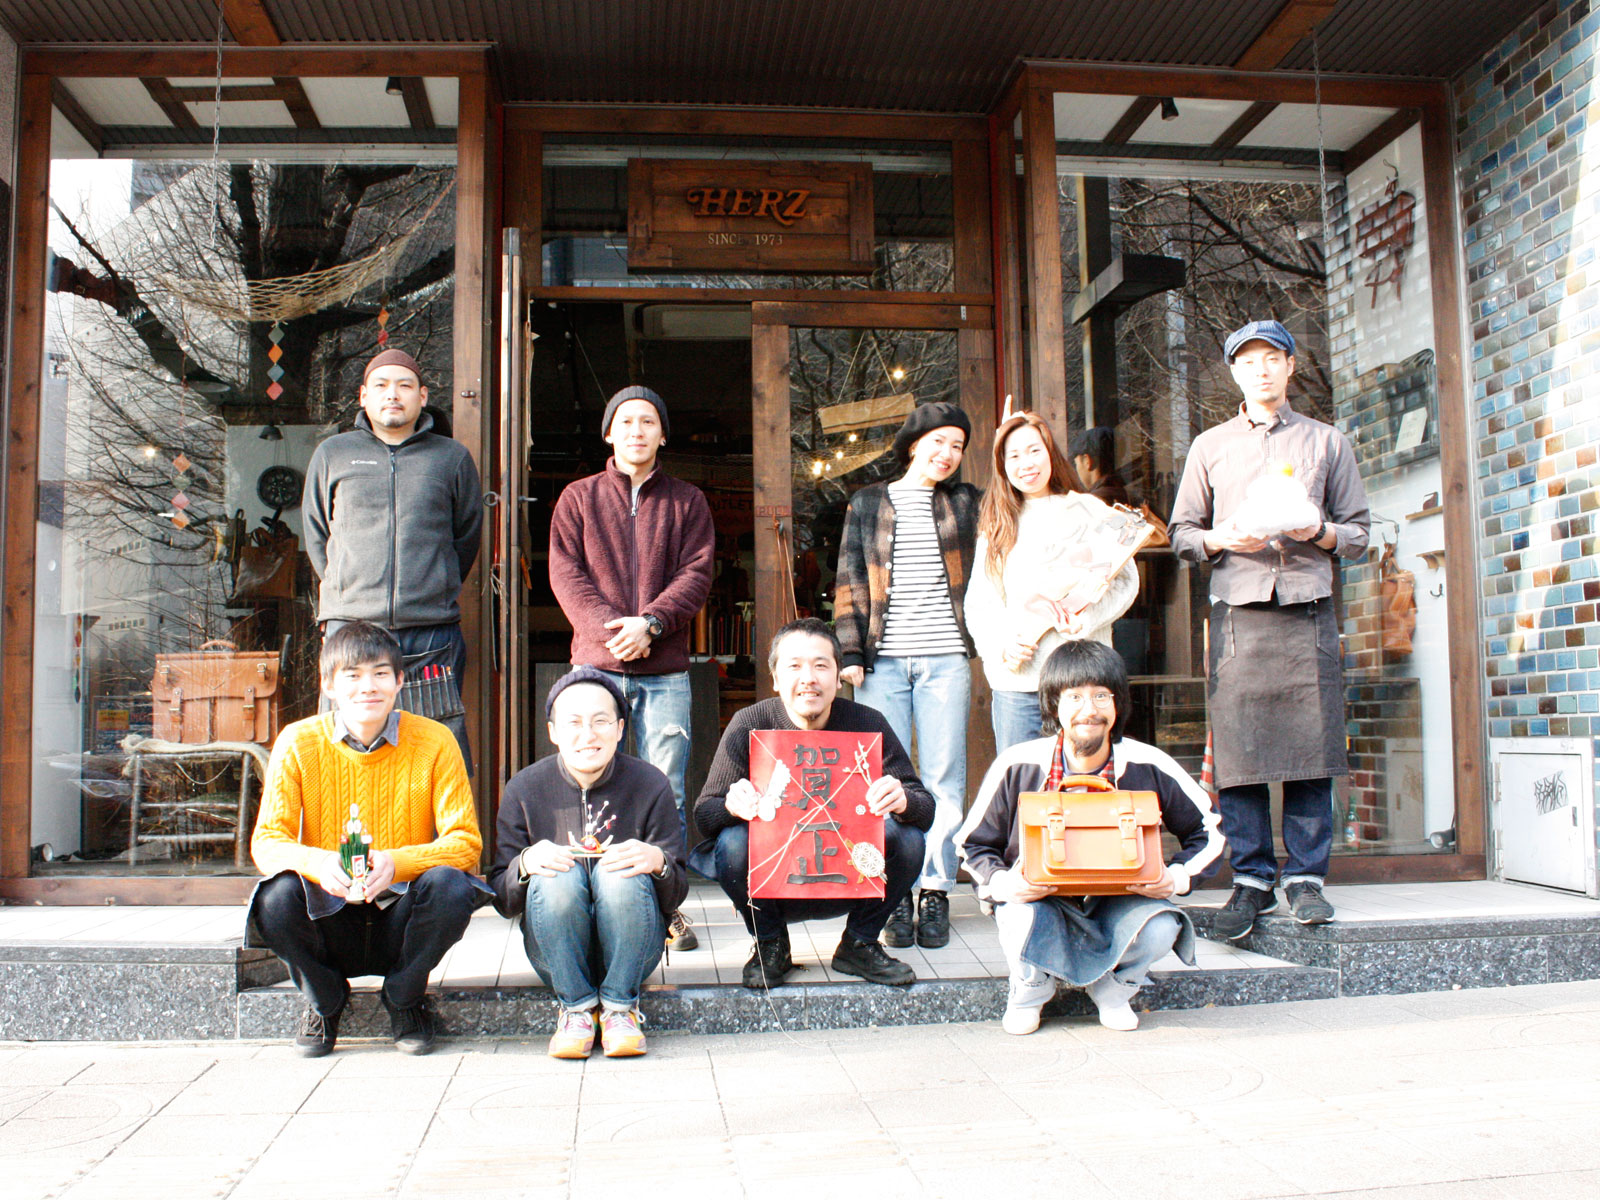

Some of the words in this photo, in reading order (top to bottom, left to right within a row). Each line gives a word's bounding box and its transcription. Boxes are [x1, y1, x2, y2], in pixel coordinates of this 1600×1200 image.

[687, 187, 811, 227] HERZ
[707, 233, 744, 246] SINCE
[754, 234, 783, 247] 1973
[707, 496, 755, 513] UTLET
[786, 743, 849, 885] 賀正
